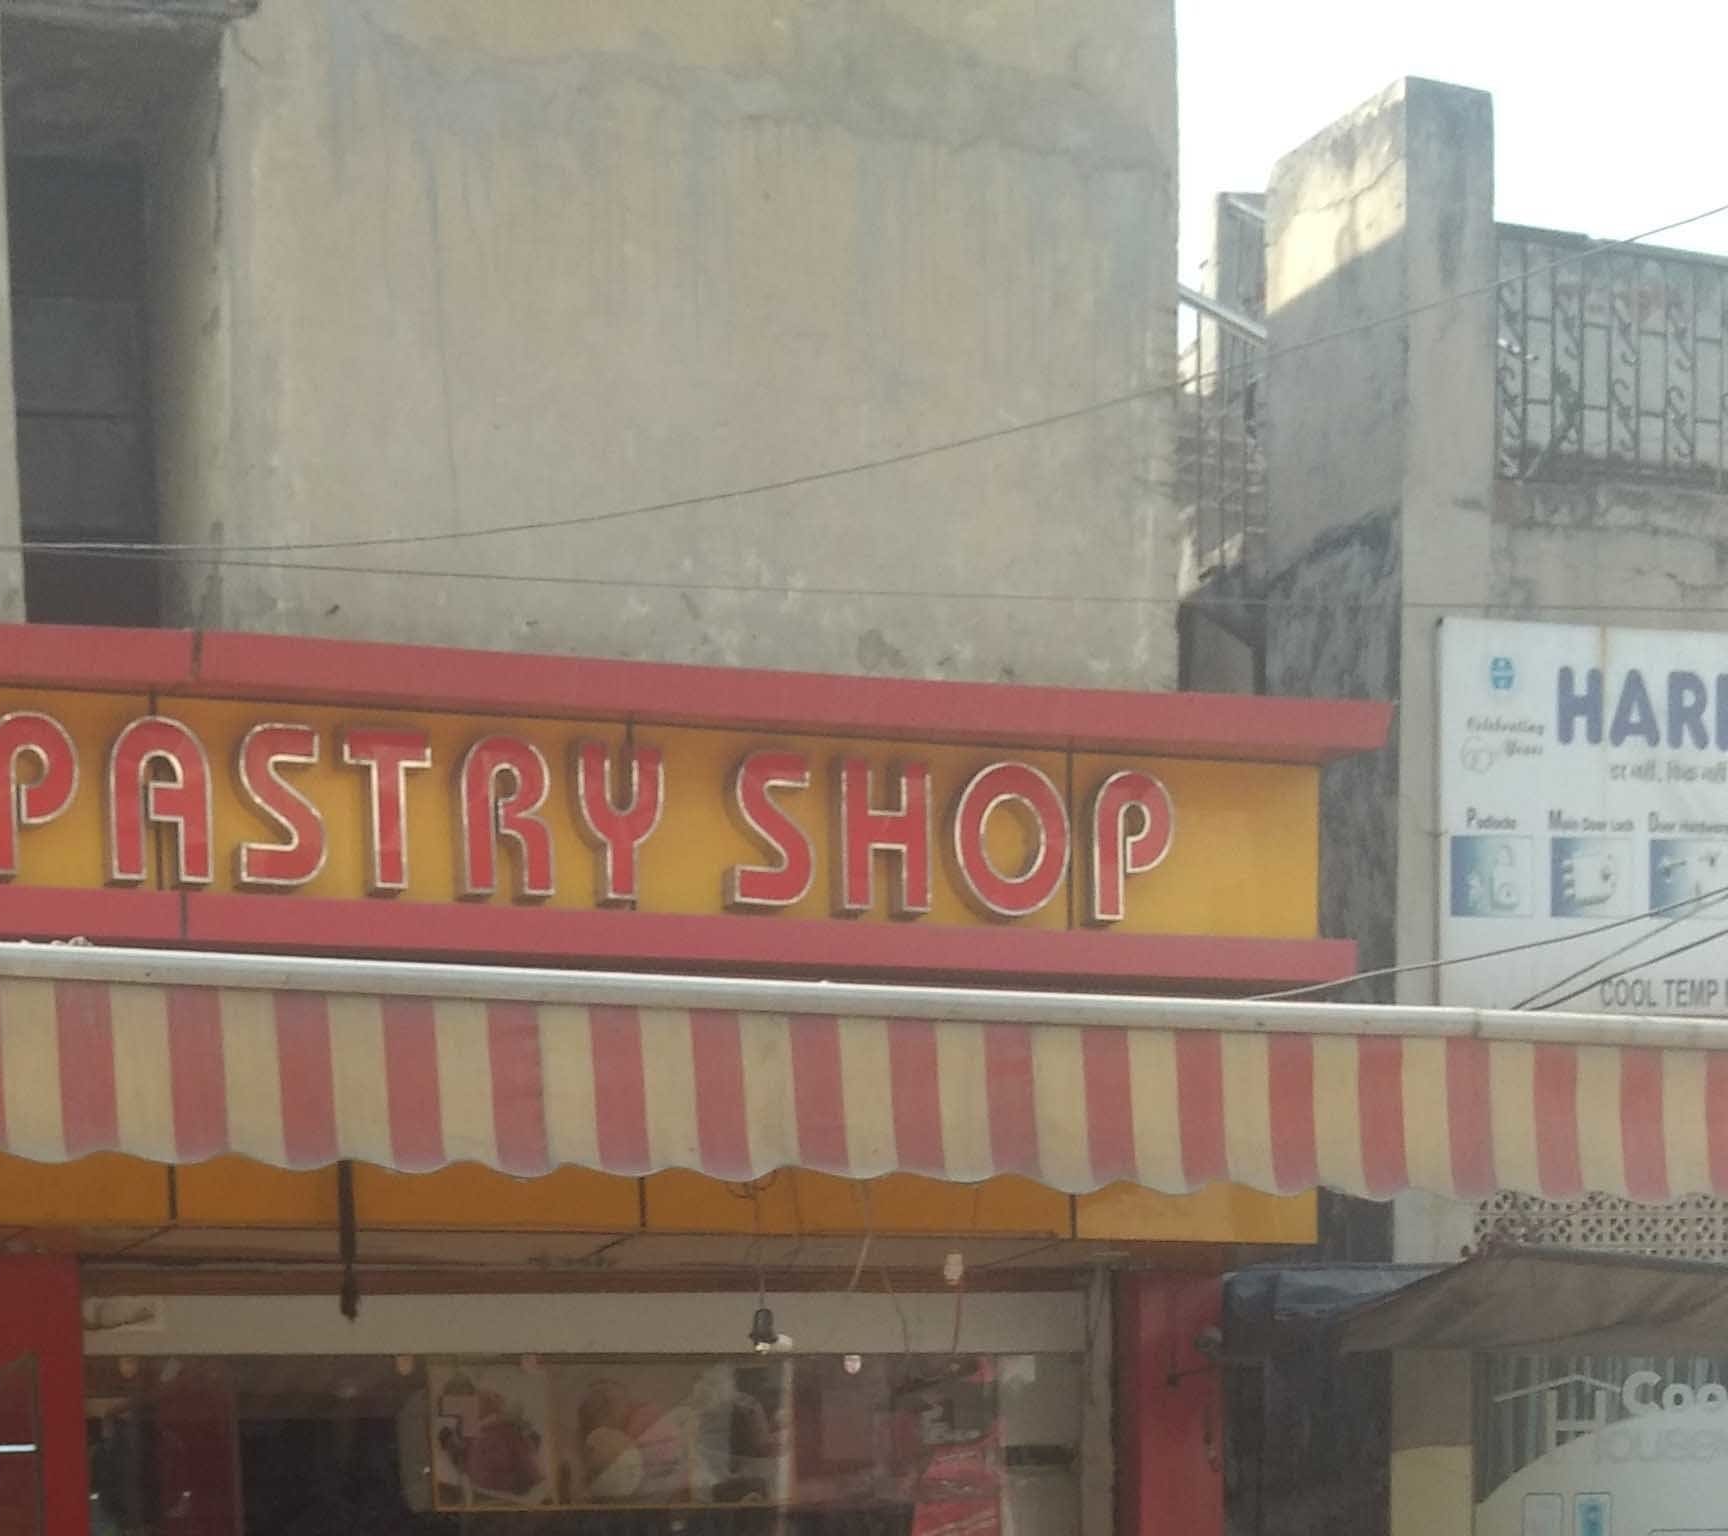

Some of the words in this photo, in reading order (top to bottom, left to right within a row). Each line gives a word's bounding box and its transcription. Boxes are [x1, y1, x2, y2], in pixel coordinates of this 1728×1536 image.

[722, 753, 1174, 925] SHOP
[1600, 978, 1658, 1008] COOL
[1663, 978, 1719, 1008] TEMP
